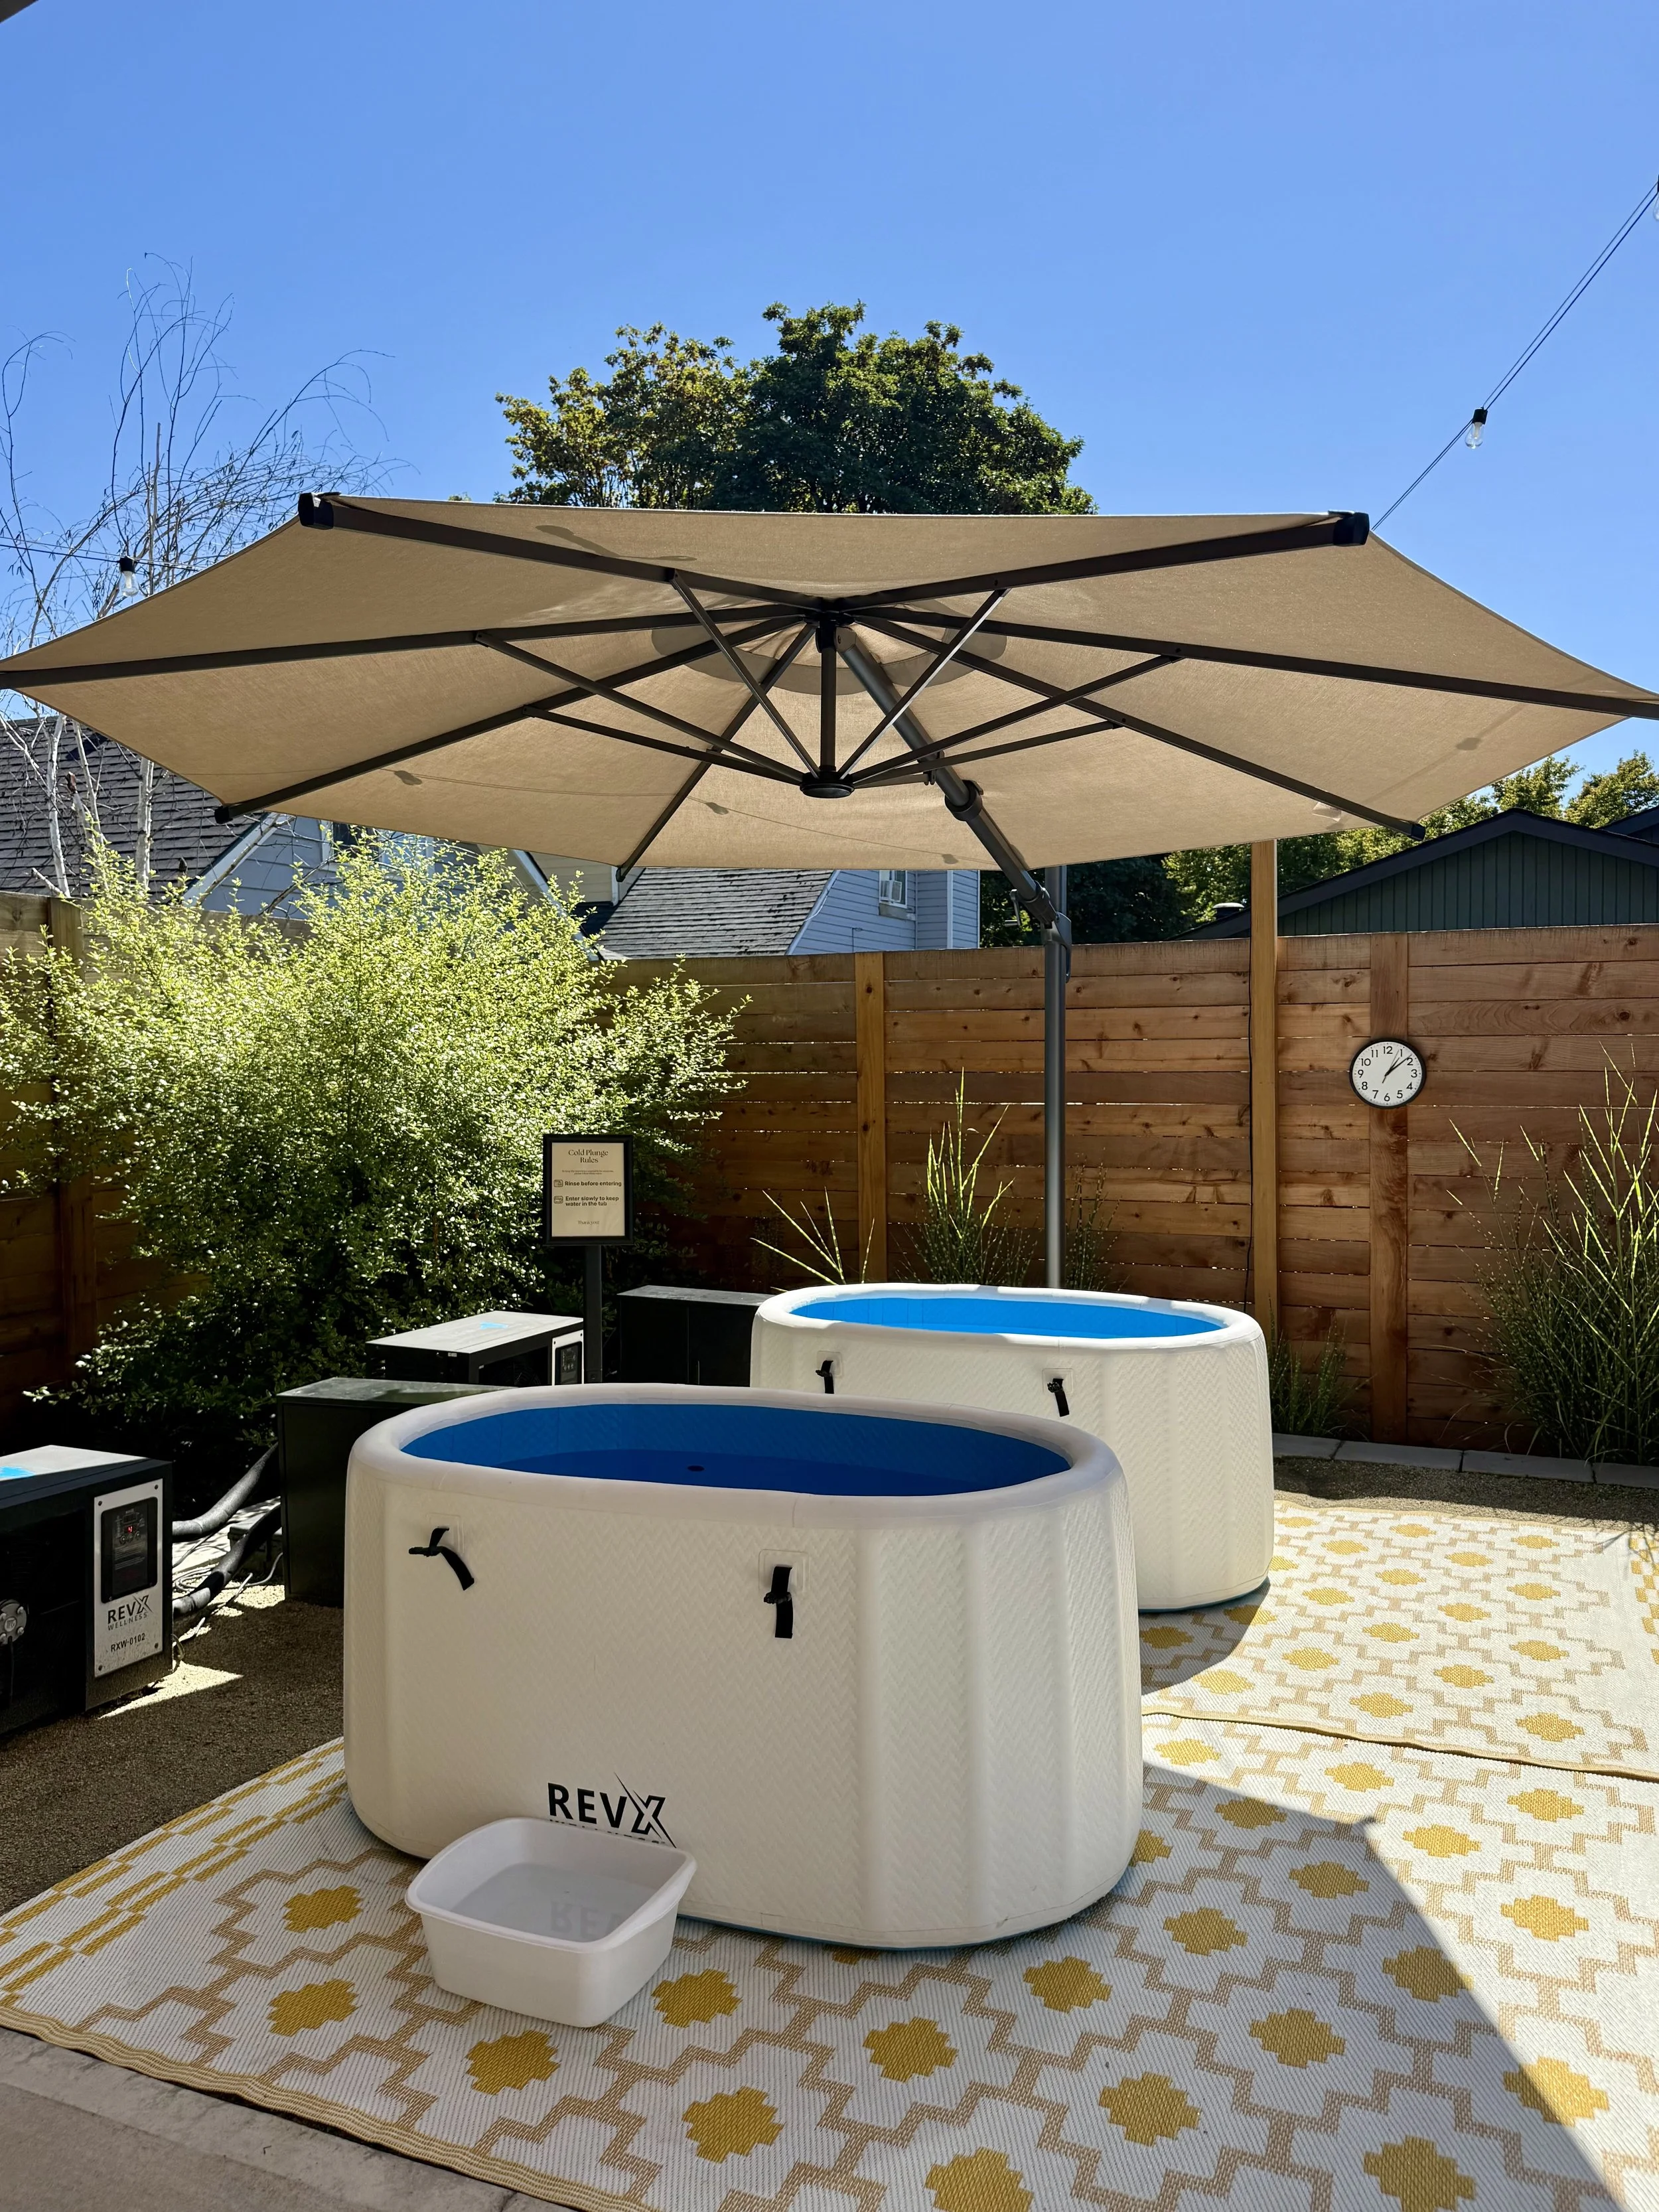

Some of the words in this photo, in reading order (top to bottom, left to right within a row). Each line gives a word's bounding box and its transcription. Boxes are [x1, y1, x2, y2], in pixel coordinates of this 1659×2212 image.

[1371, 1049, 1378, 1058] 11
[1407, 1057, 1413, 1066] 2
[1358, 1069, 1364, 1078] 9
[1411, 1069, 1417, 1078] 3
[1362, 1081, 1368, 1090] 8
[1372, 1090, 1378, 1098] 7
[1384, 1093, 1390, 1102] 6
[1396, 1090, 1403, 1098] 5
[108, 1595, 153, 1625] REVX
[108, 1611, 148, 1631] WELLNESS
[111, 1633, 145, 1652] RXW-0102
[547, 1772, 676, 1848] REVX
